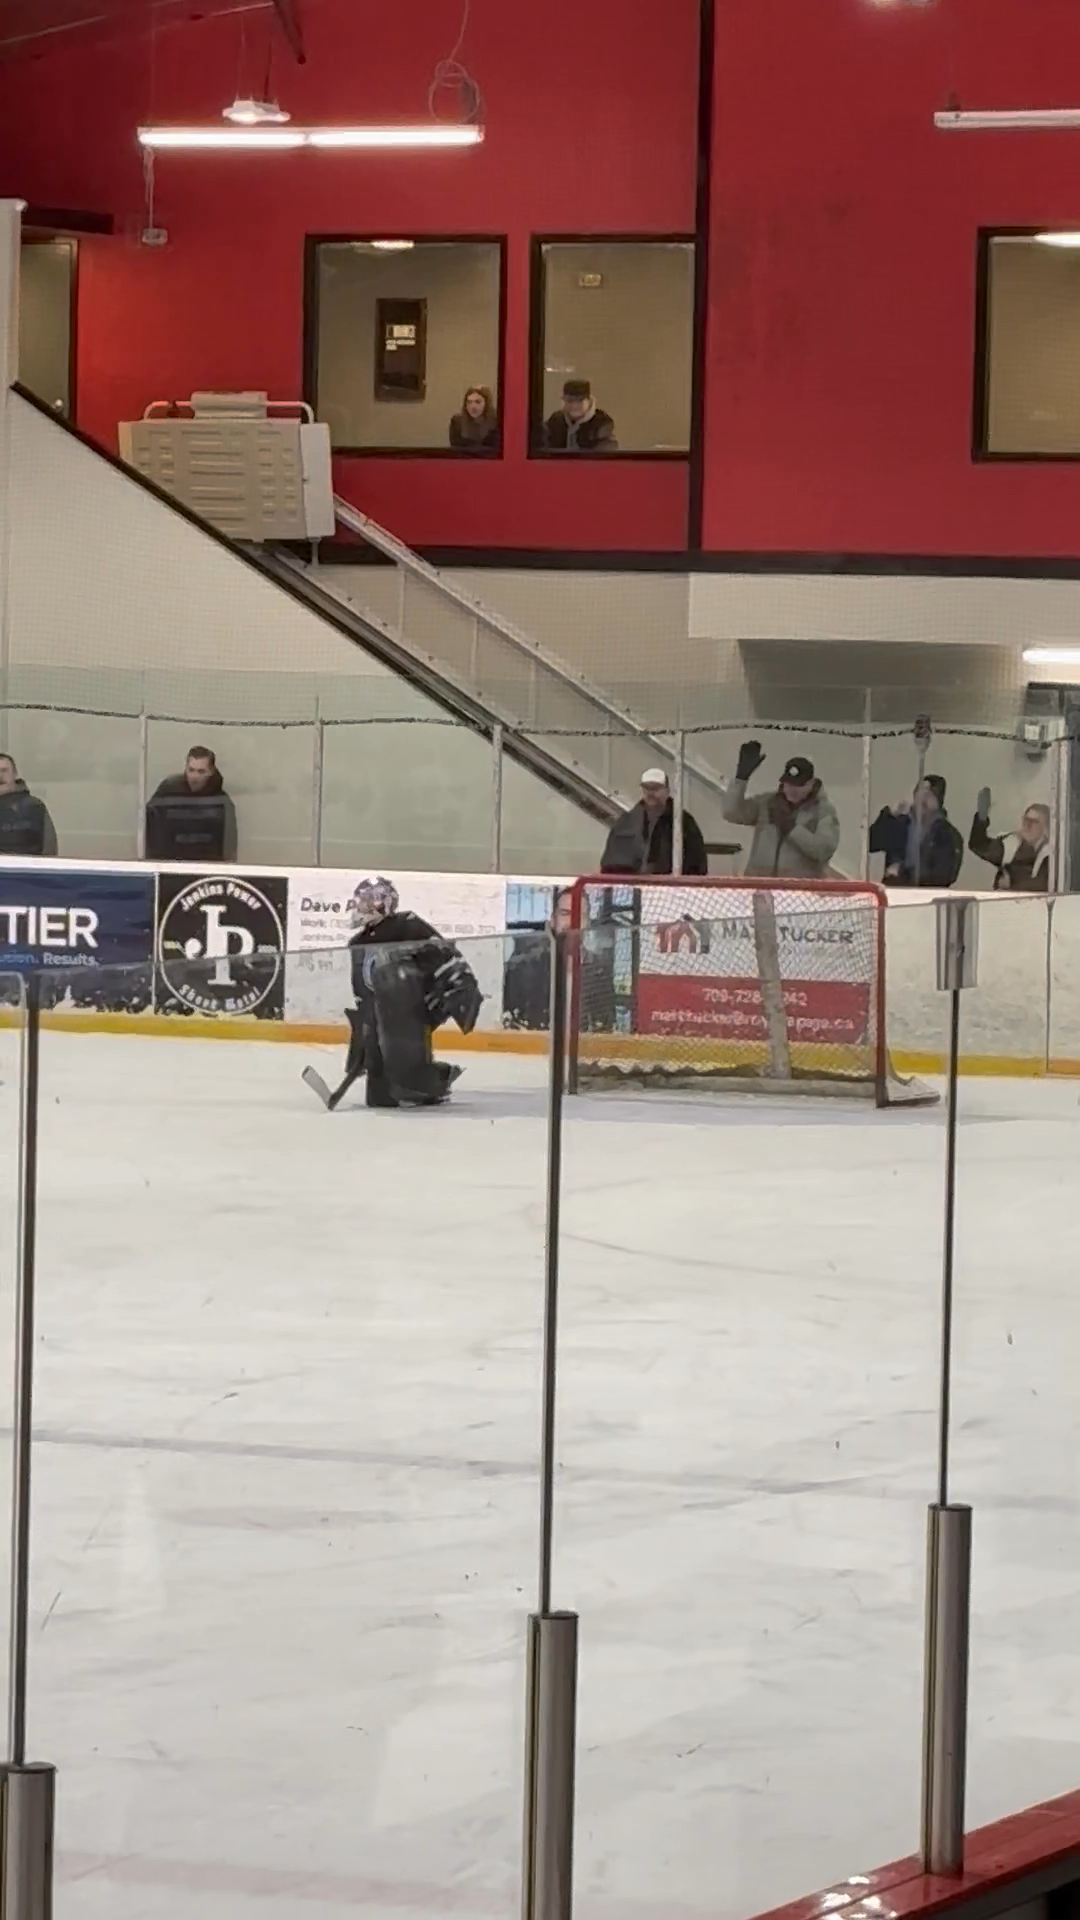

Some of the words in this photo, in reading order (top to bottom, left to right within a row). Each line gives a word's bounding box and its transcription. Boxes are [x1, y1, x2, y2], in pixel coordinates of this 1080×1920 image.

[301, 897, 341, 913] Dave
[0, 905, 99, 948] TIER
[778, 926, 855, 944] TUCKER
